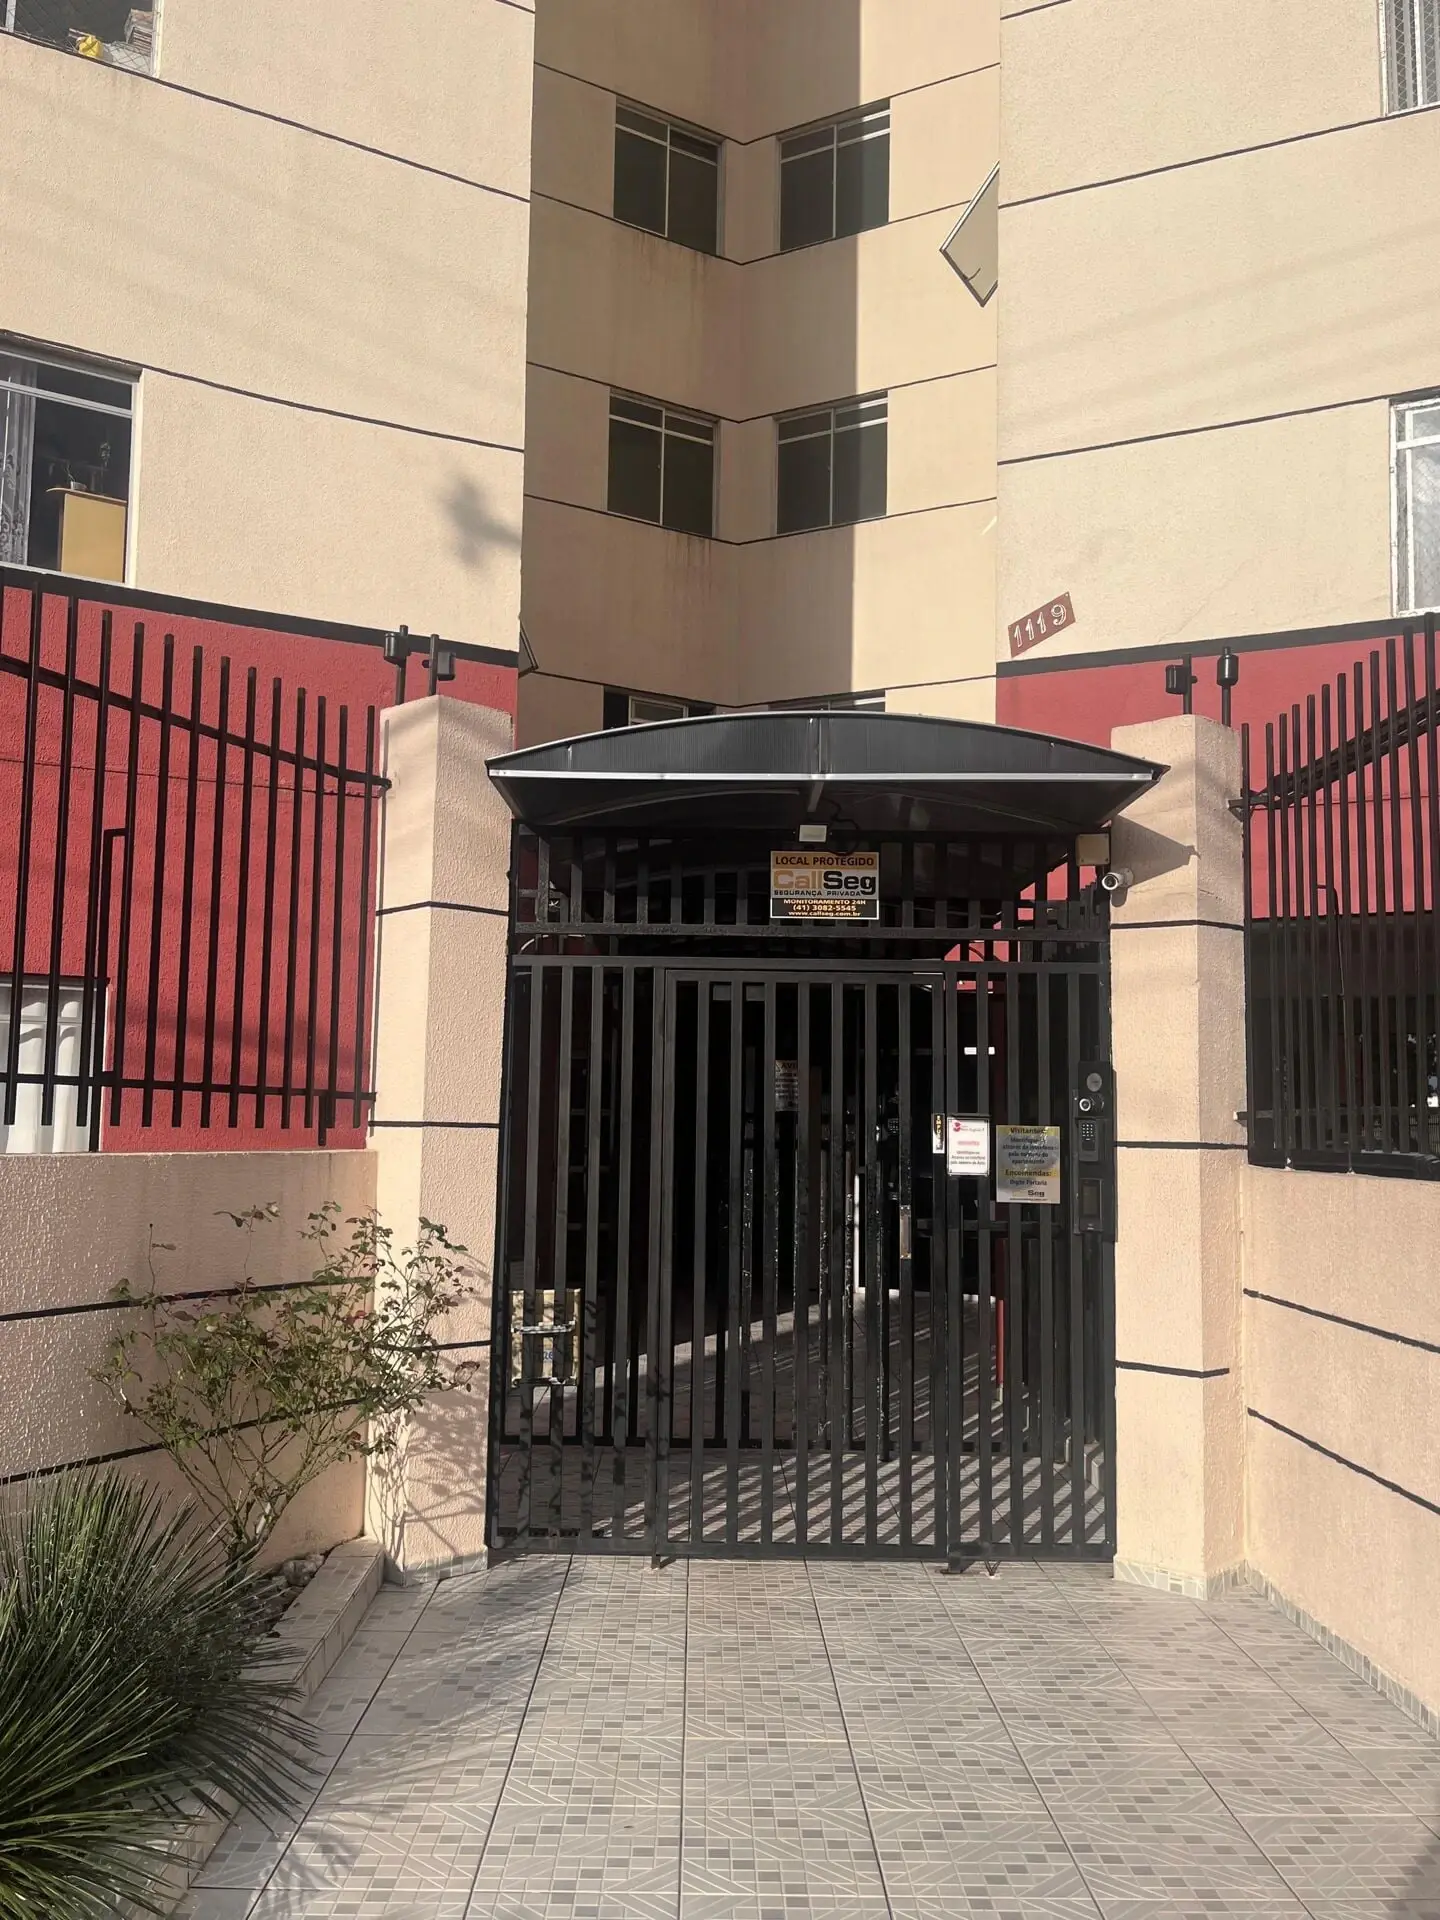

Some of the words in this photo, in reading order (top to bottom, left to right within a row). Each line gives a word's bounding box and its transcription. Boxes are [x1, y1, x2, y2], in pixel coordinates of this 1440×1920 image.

[1013, 603, 1067, 648] 1119
[775, 856, 809, 866] LOCAL
[813, 856, 875, 866] PROTEGIDO
[773, 869, 877, 896] CallSeg
[773, 890, 823, 898] SEGURANÇA
[792, 904, 810, 912] (41)
